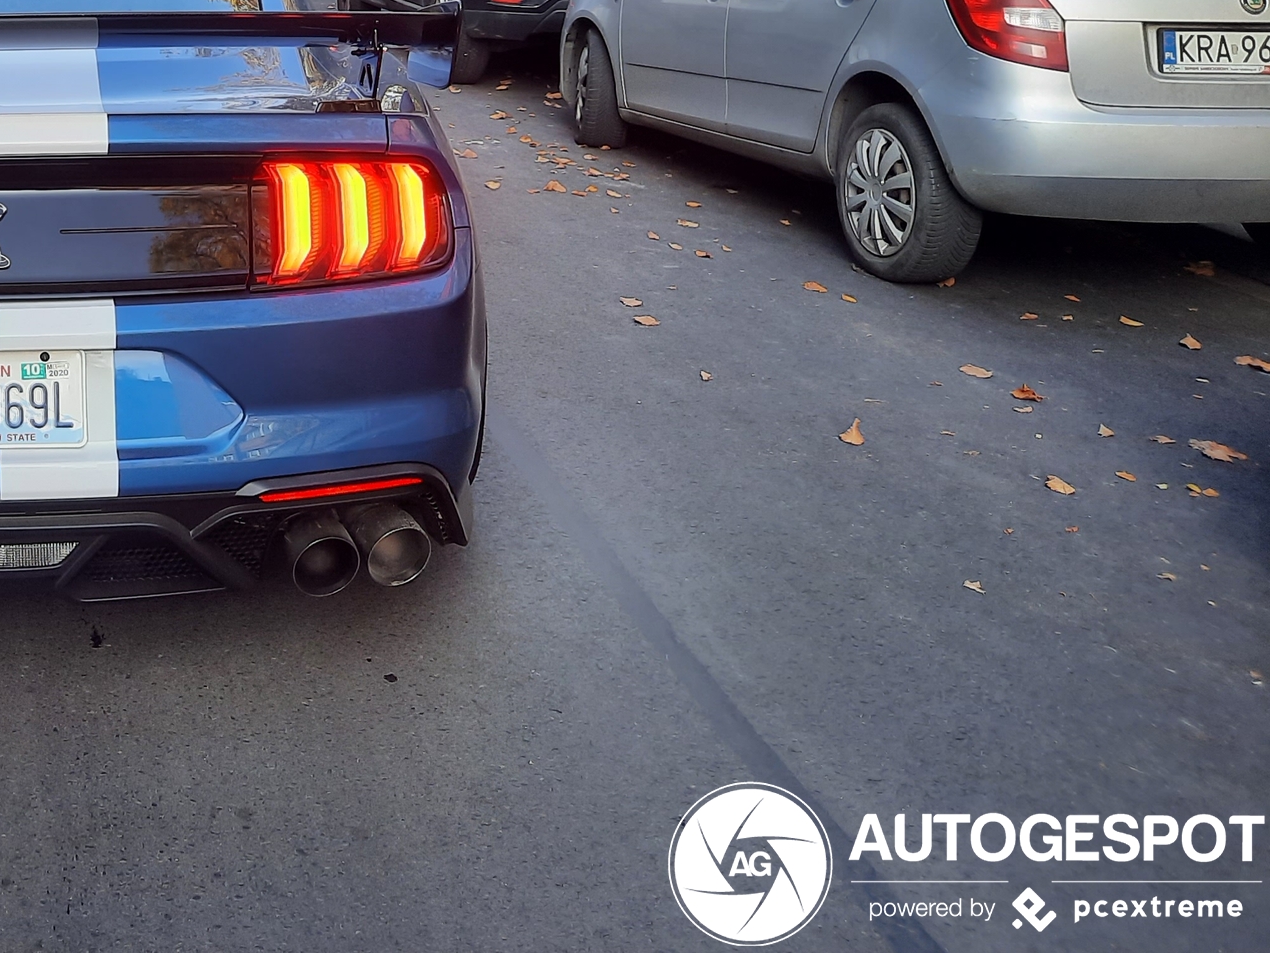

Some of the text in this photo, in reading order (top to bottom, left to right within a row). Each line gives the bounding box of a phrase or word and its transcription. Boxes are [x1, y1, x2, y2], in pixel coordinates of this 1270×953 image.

[1164, 51, 1176, 61] PL
[1178, 34, 1233, 63] KRA
[23, 363, 41, 376] 10
[48, 369, 69, 377] 2020
[7, 433, 37, 442] STATE
